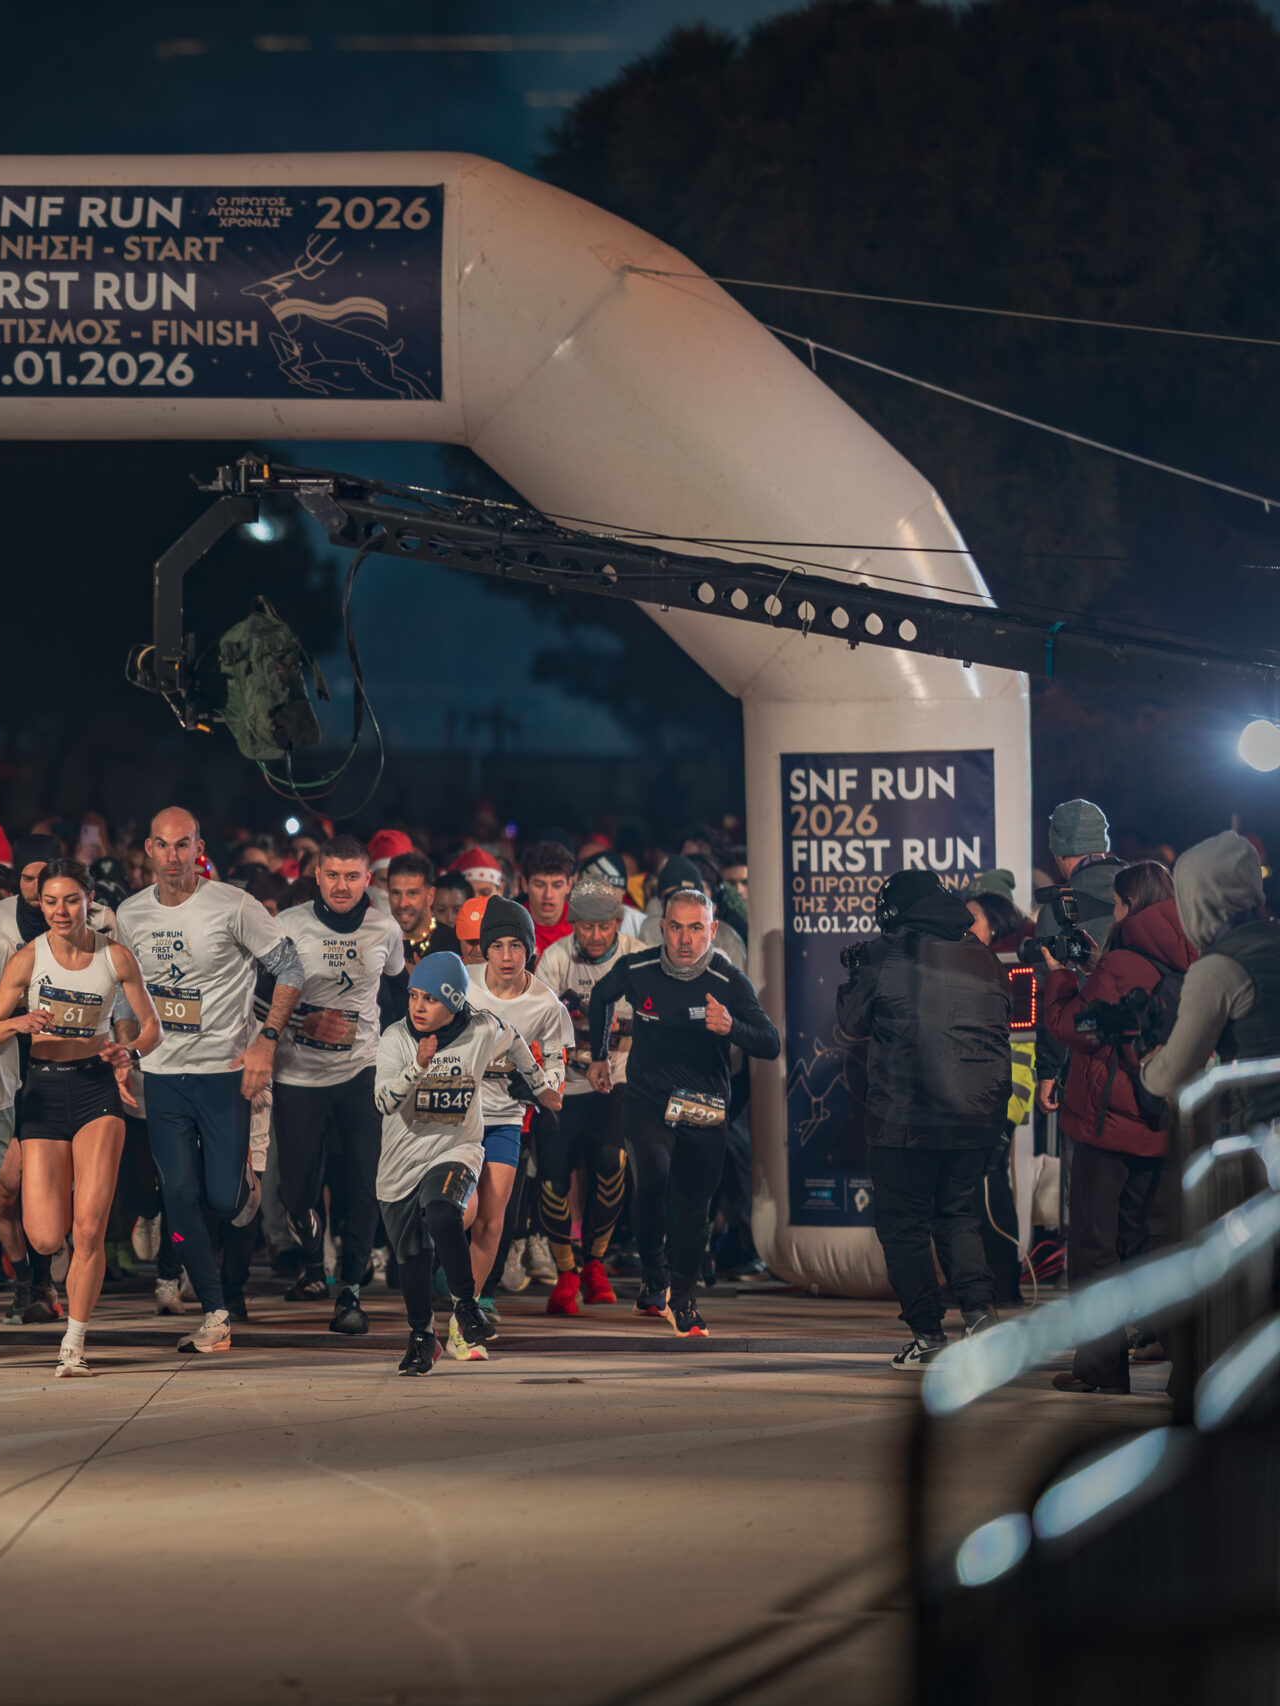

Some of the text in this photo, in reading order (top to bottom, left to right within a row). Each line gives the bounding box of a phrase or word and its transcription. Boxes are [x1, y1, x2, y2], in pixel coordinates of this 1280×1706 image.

[230, 197, 287, 206] ΠΡΩΤΟΣ
[78, 196, 183, 229] RUN
[207, 207, 294, 217] ΑΓΩΝΑΣ ΤΗΣ
[314, 196, 432, 230] 2026
[218, 217, 281, 227] ΧΡΟΝΙΑΣ
[123, 235, 225, 262] START
[93, 272, 196, 312] RUN
[152, 319, 260, 346] FINISH
[789, 765, 955, 802] SNF RUN
[790, 803, 879, 837] 2026
[791, 836, 981, 873] FIRST RUN
[811, 876, 890, 894] ΠΡΩΤΟ
[792, 896, 828, 914] ΤΗΣ
[793, 915, 882, 934] 01.01.202
[151, 930, 183, 939] SNF RUN
[151, 946, 171, 954] FIRST
[157, 953, 174, 961] RUN
[328, 960, 346, 968] RUN
[63, 1007, 84, 1023] 61
[163, 1001, 187, 1018] 50
[442, 1056, 461, 1064] RUN
[432, 1091, 473, 1109] 1348
